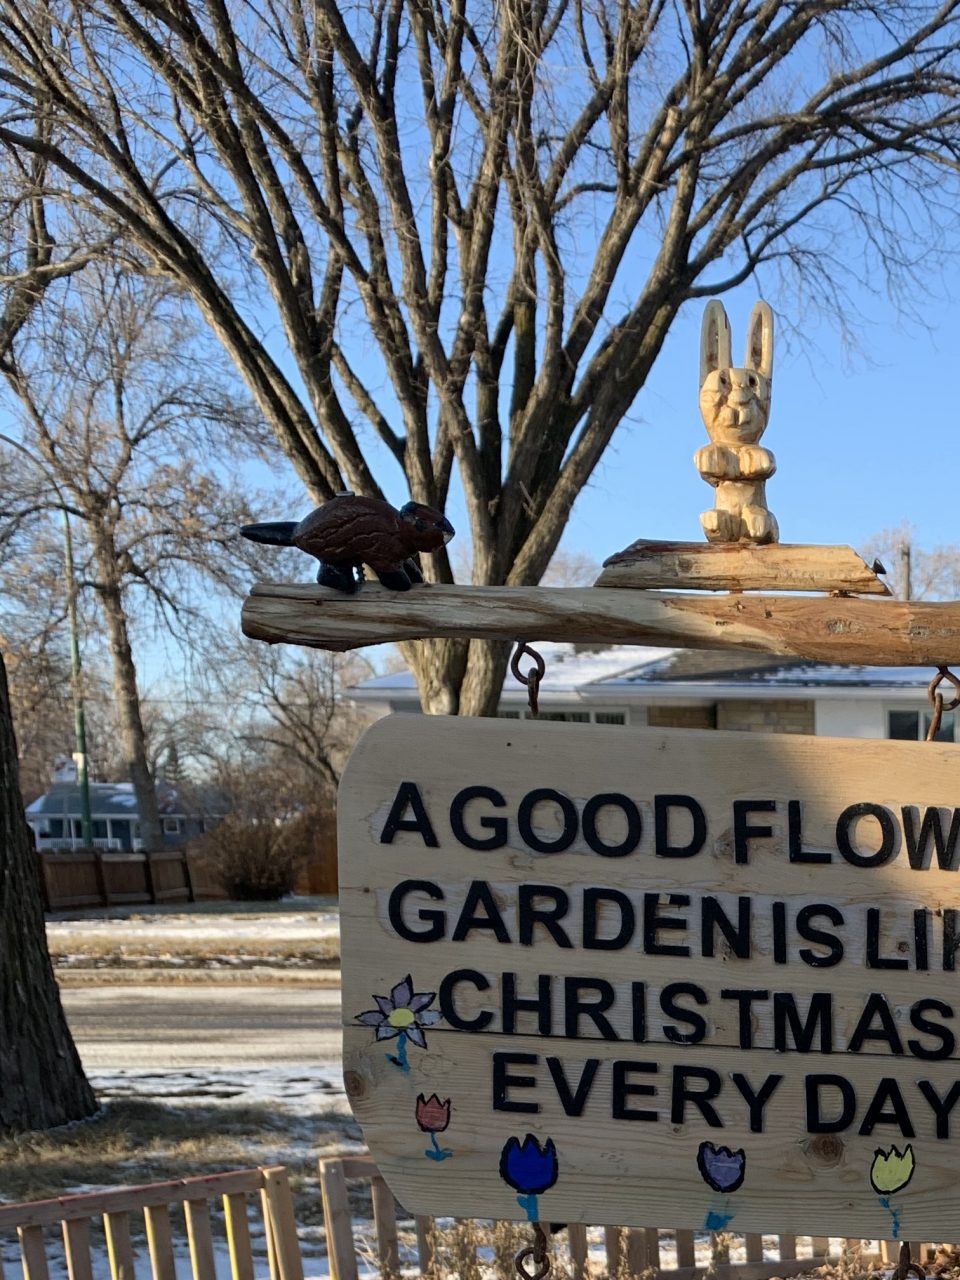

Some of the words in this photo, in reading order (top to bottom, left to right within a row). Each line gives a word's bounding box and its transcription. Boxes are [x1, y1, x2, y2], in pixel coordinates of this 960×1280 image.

[380, 782, 441, 848] A
[449, 785, 708, 859] GOOD
[387, 879, 751, 961] GARDEN
[771, 901, 846, 969] IS
[438, 968, 957, 1060] CHRISTMAS
[492, 1052, 784, 1134] EVERY
